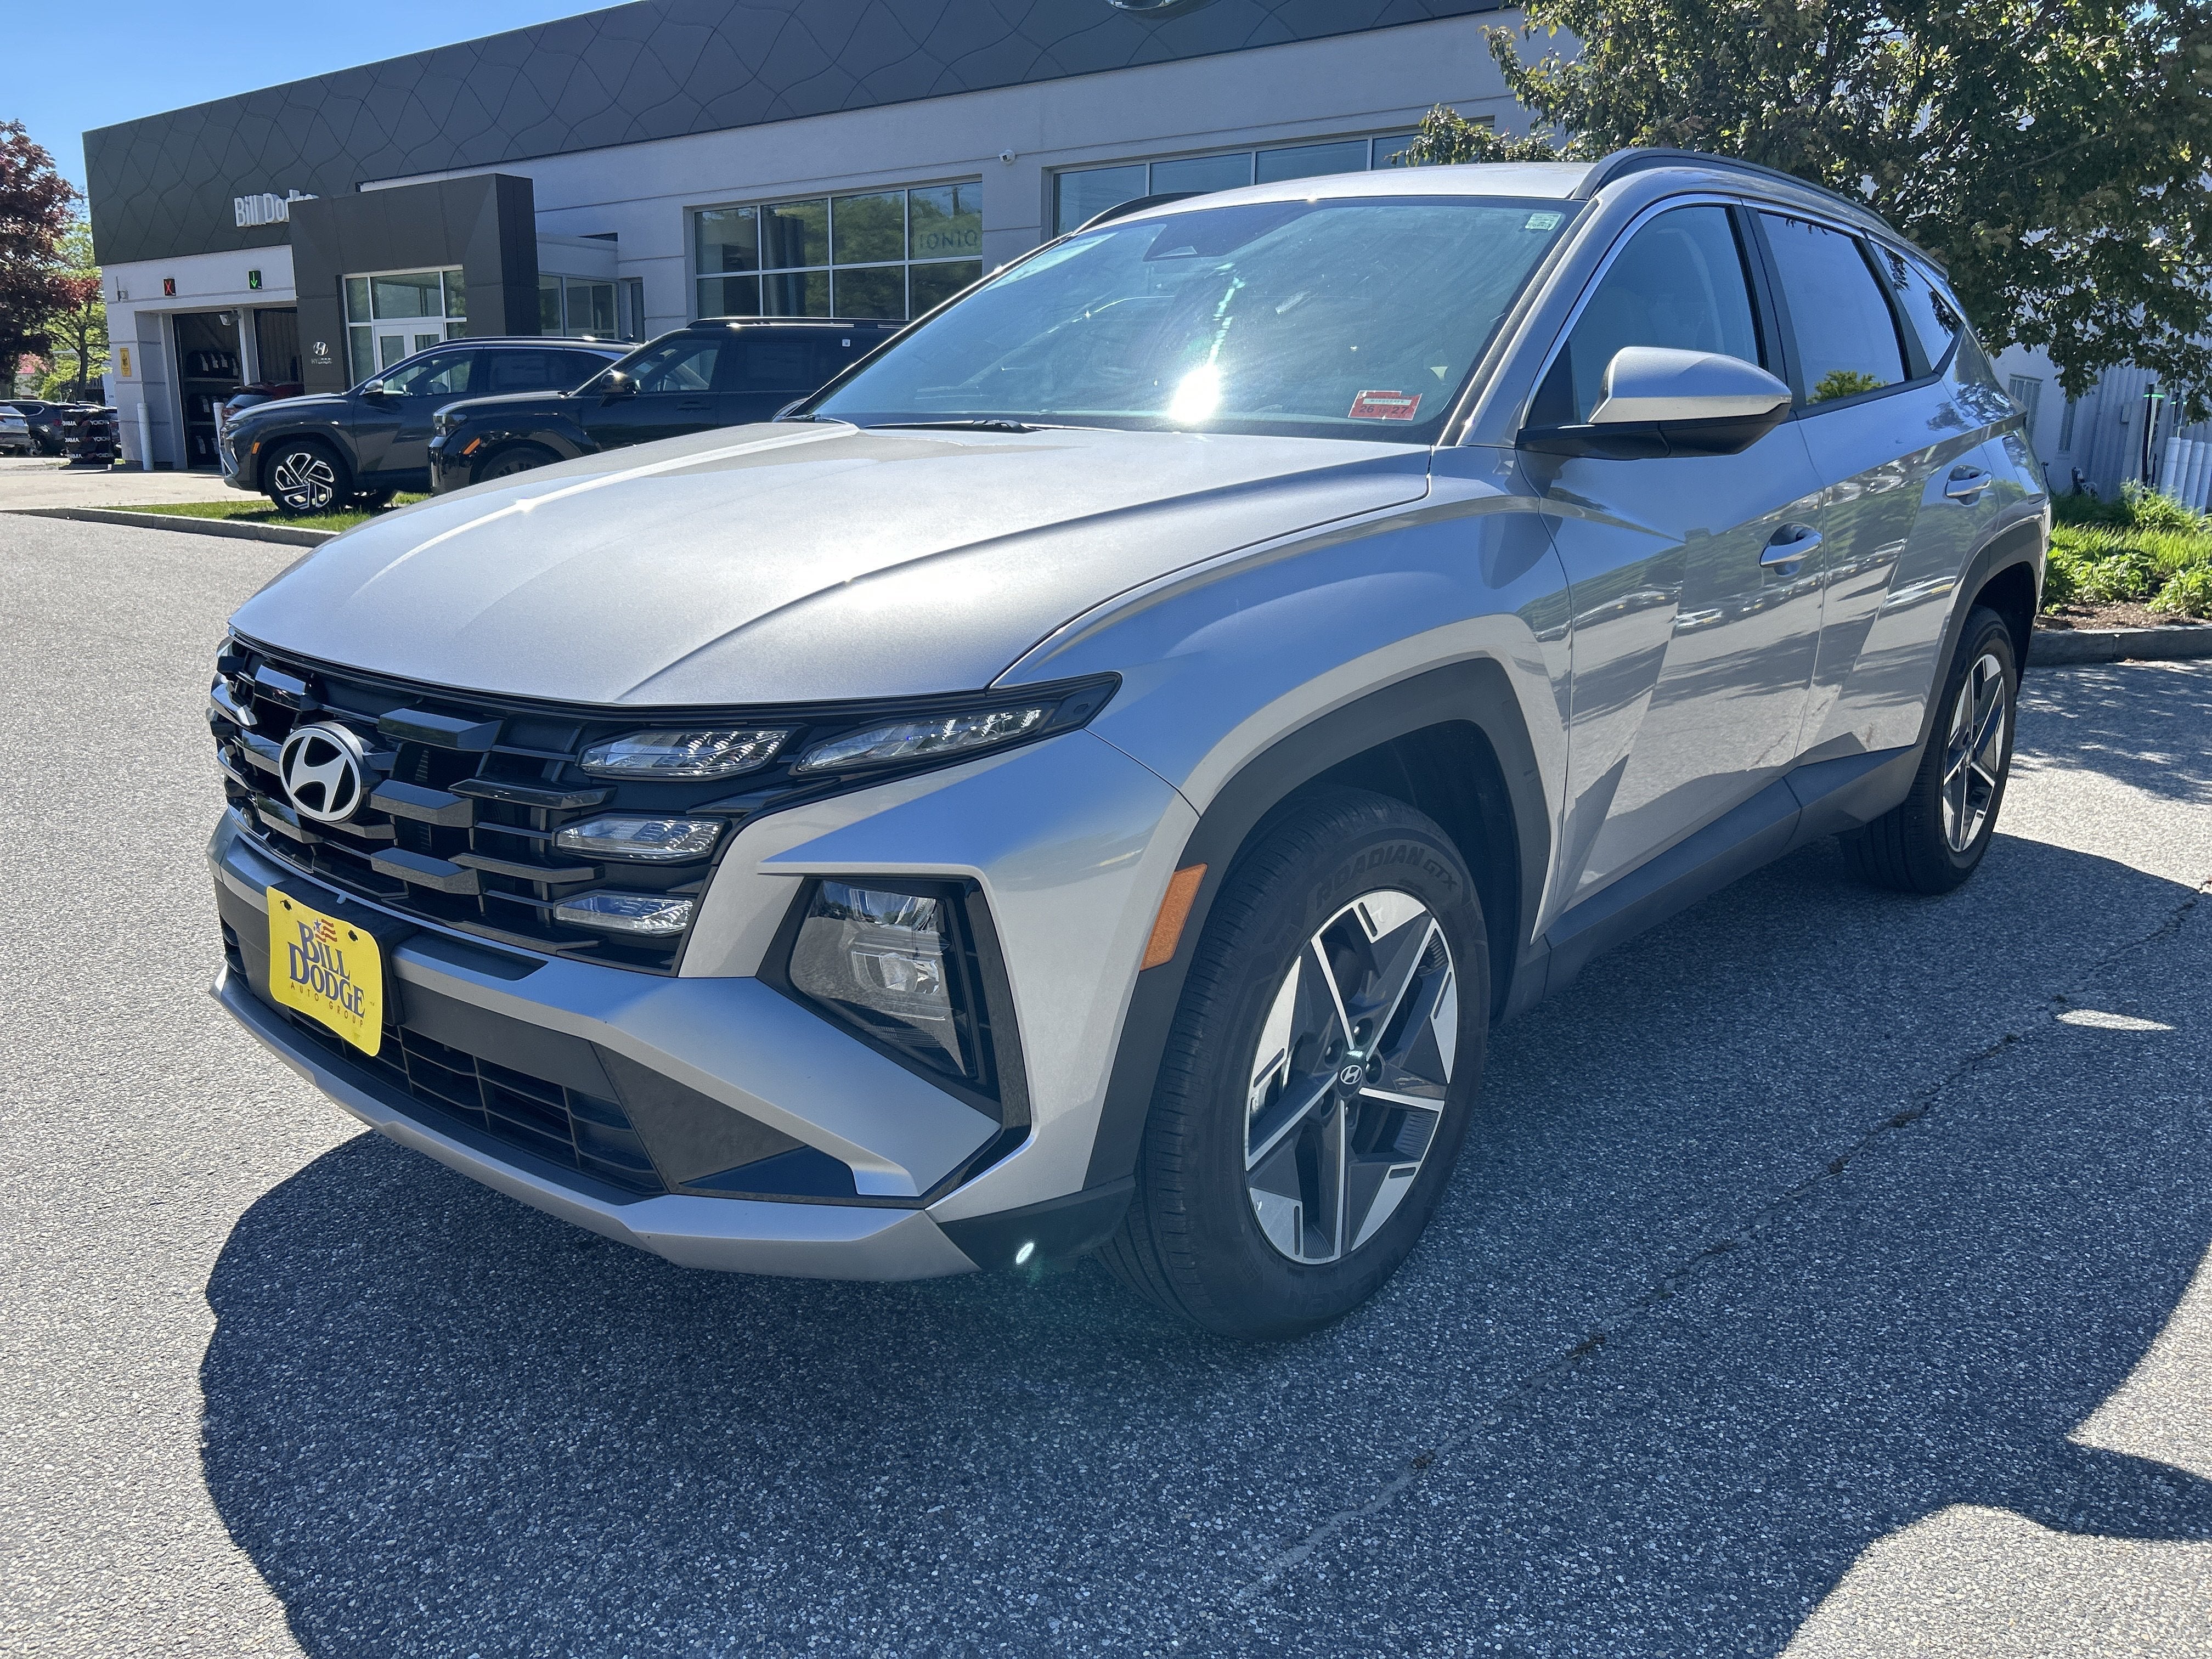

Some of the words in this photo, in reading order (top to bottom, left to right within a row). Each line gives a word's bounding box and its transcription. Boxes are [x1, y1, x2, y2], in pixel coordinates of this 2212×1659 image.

[234, 195, 265, 227] Bill
[919, 228, 978, 251] IONIQ
[1391, 406, 1409, 414] 27
[1316, 844, 1425, 911] ROADIAN
[1423, 857, 1458, 893] GTX
[297, 920, 351, 981] BILL
[288, 941, 366, 1018] DODGE
[290, 983, 319, 1002] AUTO
[329, 1001, 364, 1028] GROUP
